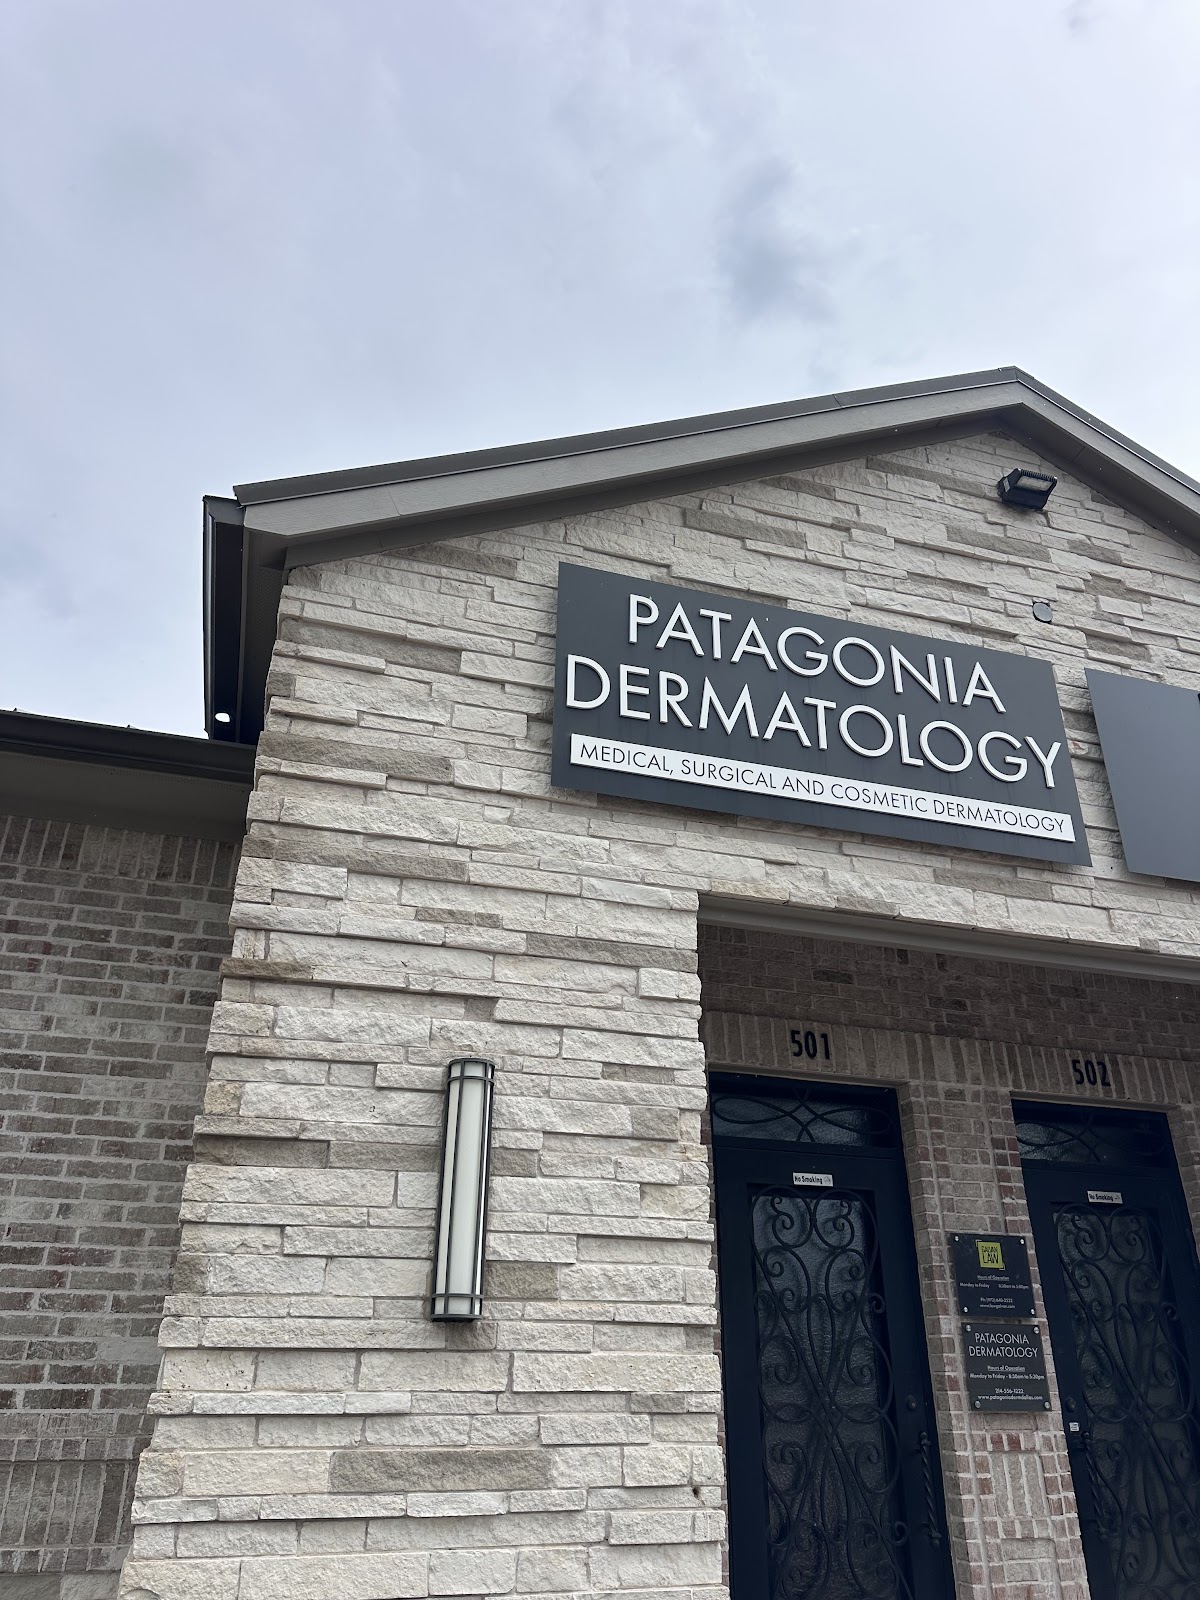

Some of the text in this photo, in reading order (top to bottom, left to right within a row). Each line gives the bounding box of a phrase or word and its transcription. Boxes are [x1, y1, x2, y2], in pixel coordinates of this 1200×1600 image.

[628, 593, 1007, 714] PATAGONIA
[565, 654, 1062, 789] DERMATOLOGY
[580, 742, 1065, 834] MEDICAL, SURGICAL AND COSMETIC DERMATOLOGY
[790, 1029, 831, 1060] 501
[1071, 1059, 1112, 1087] 502
[794, 1175, 823, 1185] No Smoking
[982, 1252, 999, 1264] LAW
[968, 1345, 1038, 1358] DERMATOLOGY
[974, 1332, 1030, 1345] PATAGONIA
